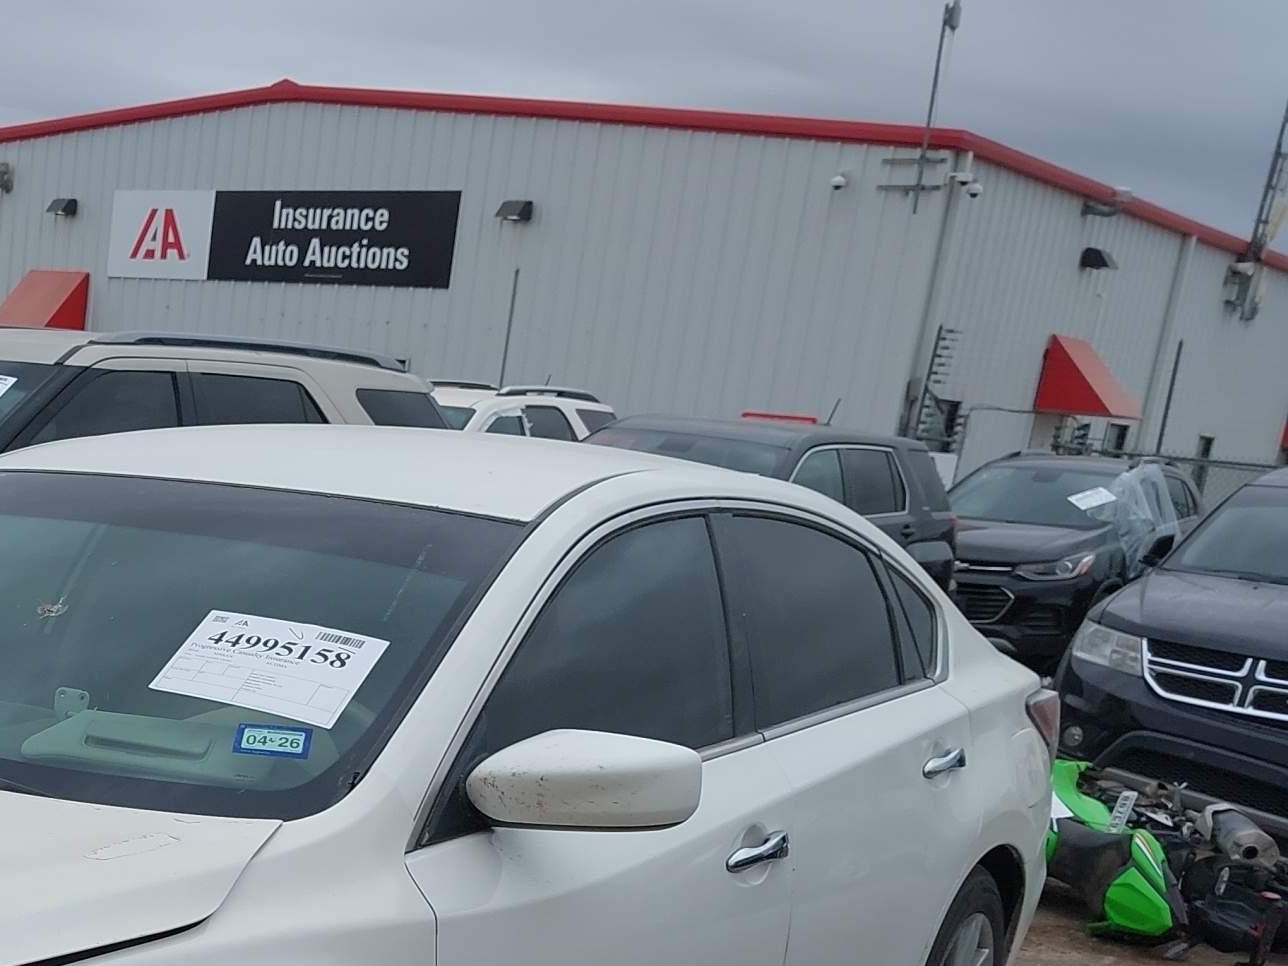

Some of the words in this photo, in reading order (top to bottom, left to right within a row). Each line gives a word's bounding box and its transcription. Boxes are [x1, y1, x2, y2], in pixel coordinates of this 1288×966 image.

[272, 199, 390, 231] Insurance
[245, 236, 299, 267] Auto
[303, 237, 410, 270] Auctions
[208, 630, 352, 669] 44995158
[245, 734, 268, 746] 04
[278, 736, 302, 749] 26
